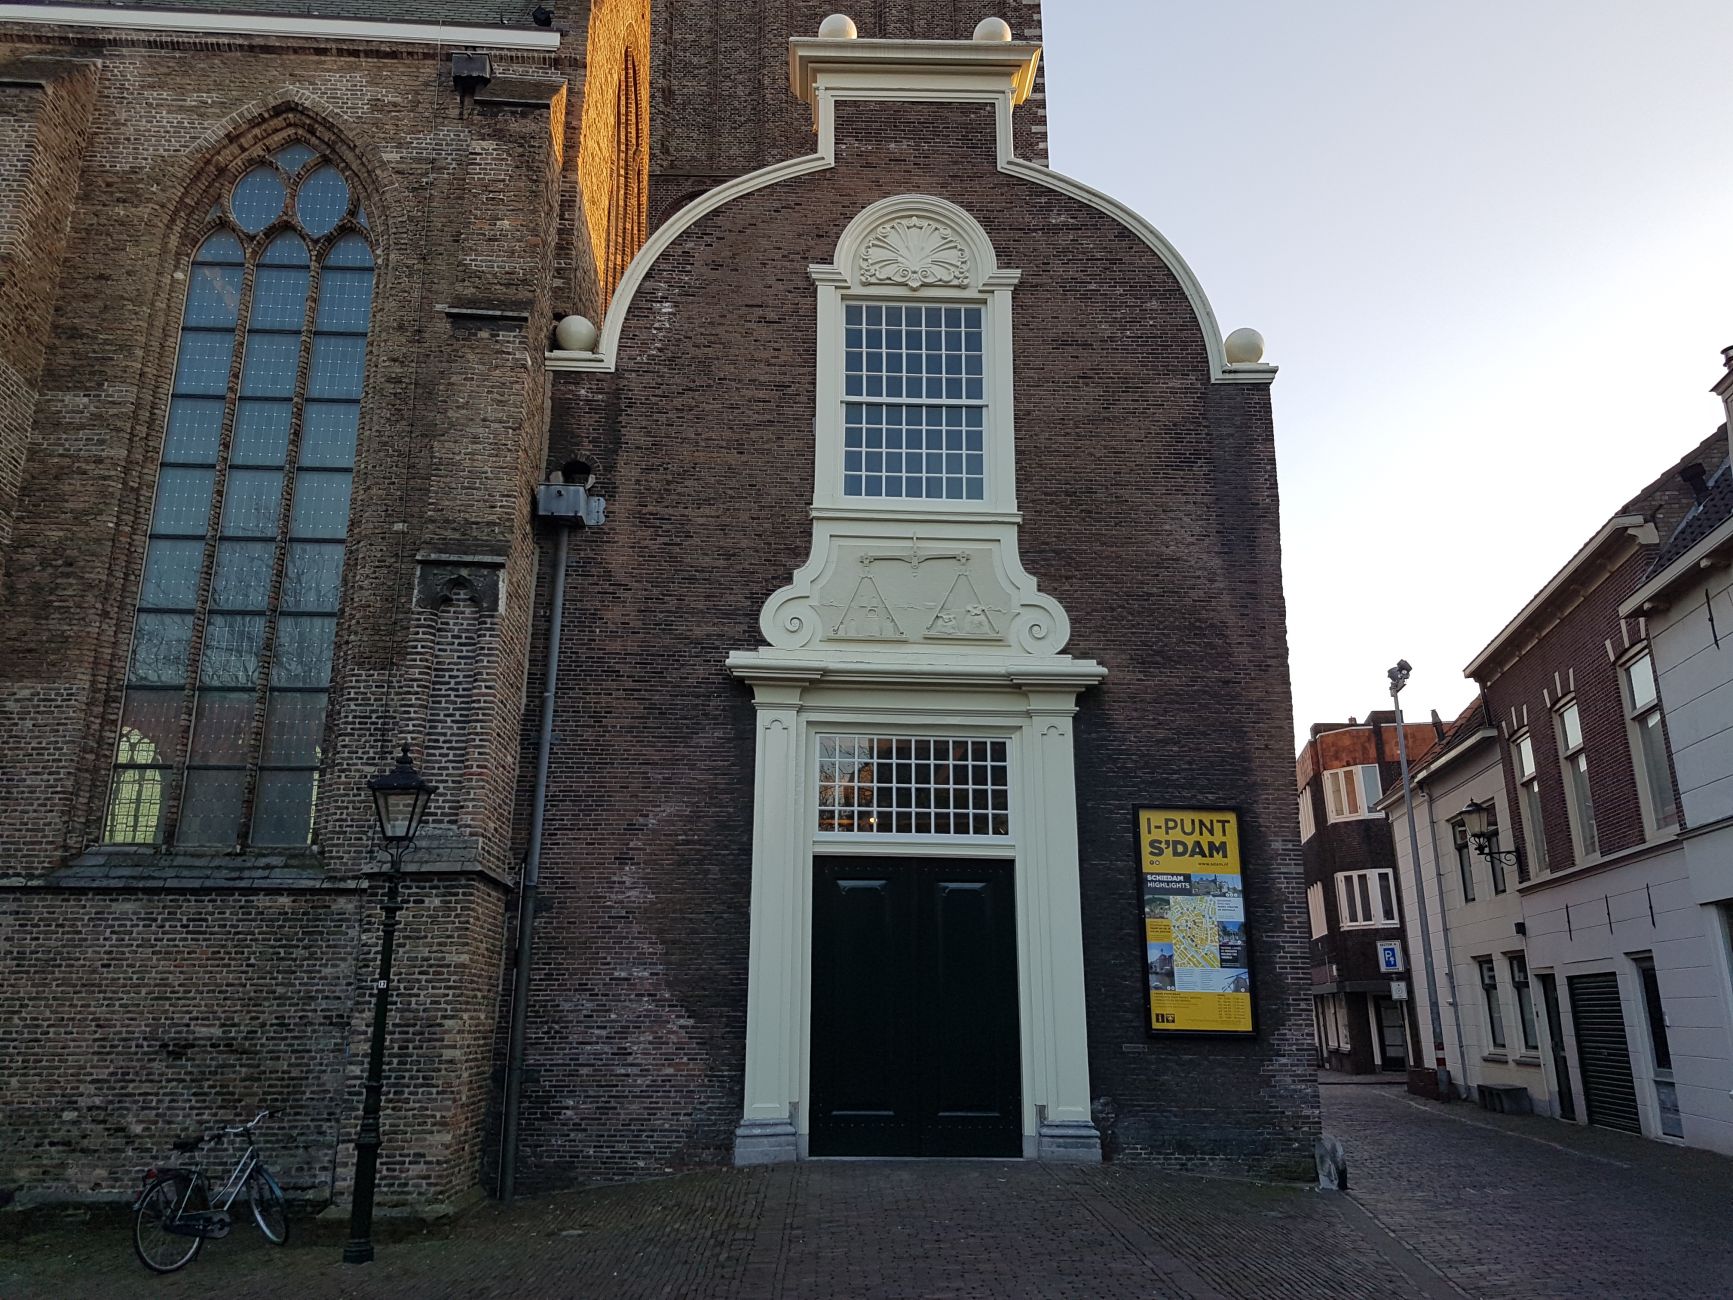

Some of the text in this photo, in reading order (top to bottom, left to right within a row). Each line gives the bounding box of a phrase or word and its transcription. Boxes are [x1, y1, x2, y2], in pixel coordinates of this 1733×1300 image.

[1146, 817, 1231, 837] I-PUNT
[1148, 838, 1228, 859] S'DAM
[1147, 874, 1184, 882] SCHIEDAM
[1147, 881, 1190, 889] HIGHLIGHTS
